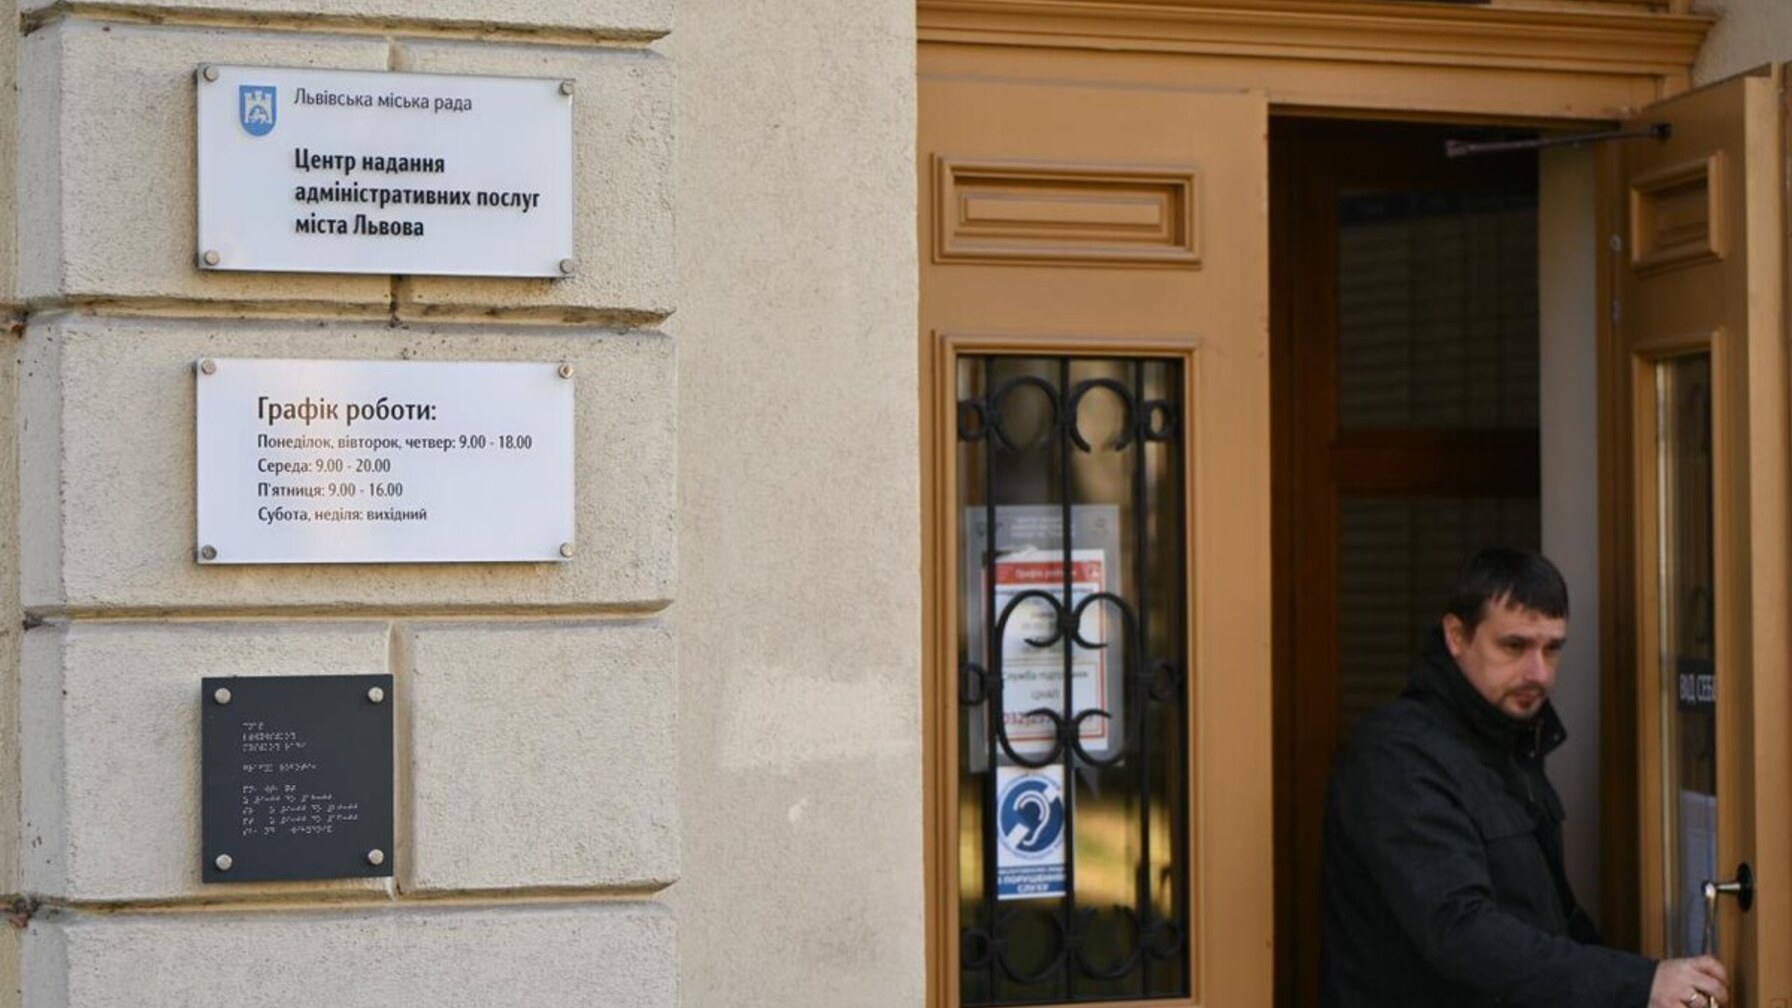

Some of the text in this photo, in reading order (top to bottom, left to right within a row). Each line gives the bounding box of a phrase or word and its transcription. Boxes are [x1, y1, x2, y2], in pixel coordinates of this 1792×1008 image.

[294, 88, 473, 113] Львівська міська рада
[294, 147, 445, 176] Центр надання
[295, 181, 540, 212] адміністративних послуг
[295, 212, 424, 236] міста Львова
[258, 396, 437, 426] Графік роботи:
[257, 433, 334, 450] Понеділок,
[338, 434, 402, 452] вівторок,
[405, 438, 456, 452] четвер:
[459, 434, 486, 449] 9.00
[499, 434, 532, 449] 18.00
[257, 458, 312, 476] Середа:
[316, 458, 343, 473] 9.00
[356, 458, 391, 473] 20.00
[257, 482, 325, 498] П'ятниця:
[328, 482, 356, 497] 9.00
[370, 482, 403, 497] 16.00
[257, 506, 428, 525] Субота, неділя: вихідний
